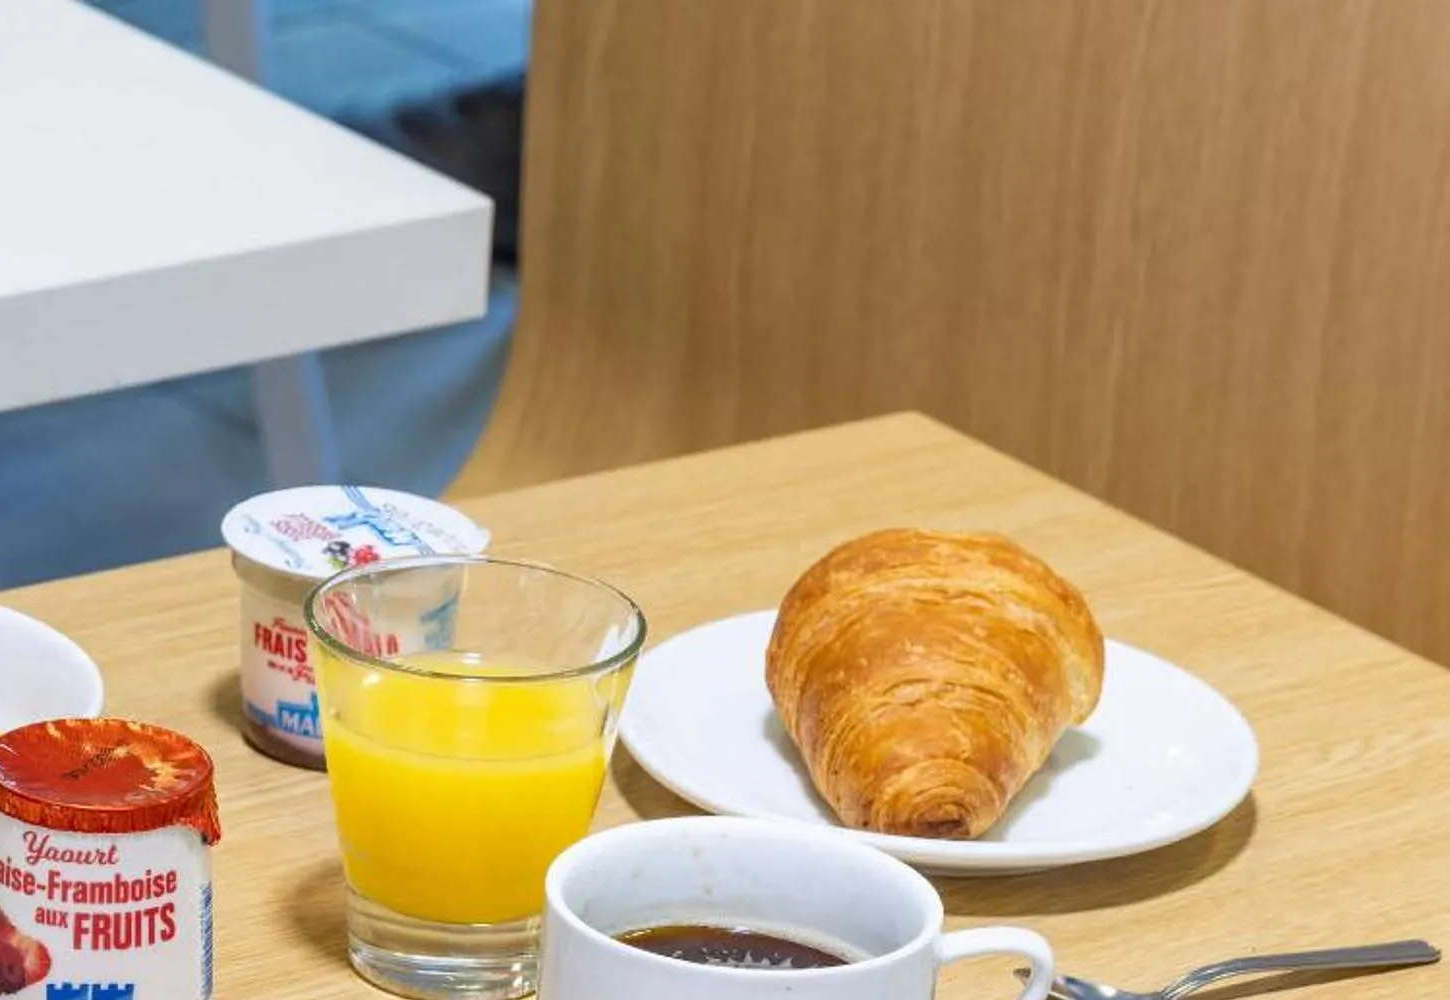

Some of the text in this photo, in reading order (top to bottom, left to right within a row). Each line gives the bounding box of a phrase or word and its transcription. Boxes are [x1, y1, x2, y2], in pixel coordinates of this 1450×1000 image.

[282, 709, 318, 736] MA
[23, 830, 119, 865] Yaourt
[35, 902, 175, 951] aux FRUITS
